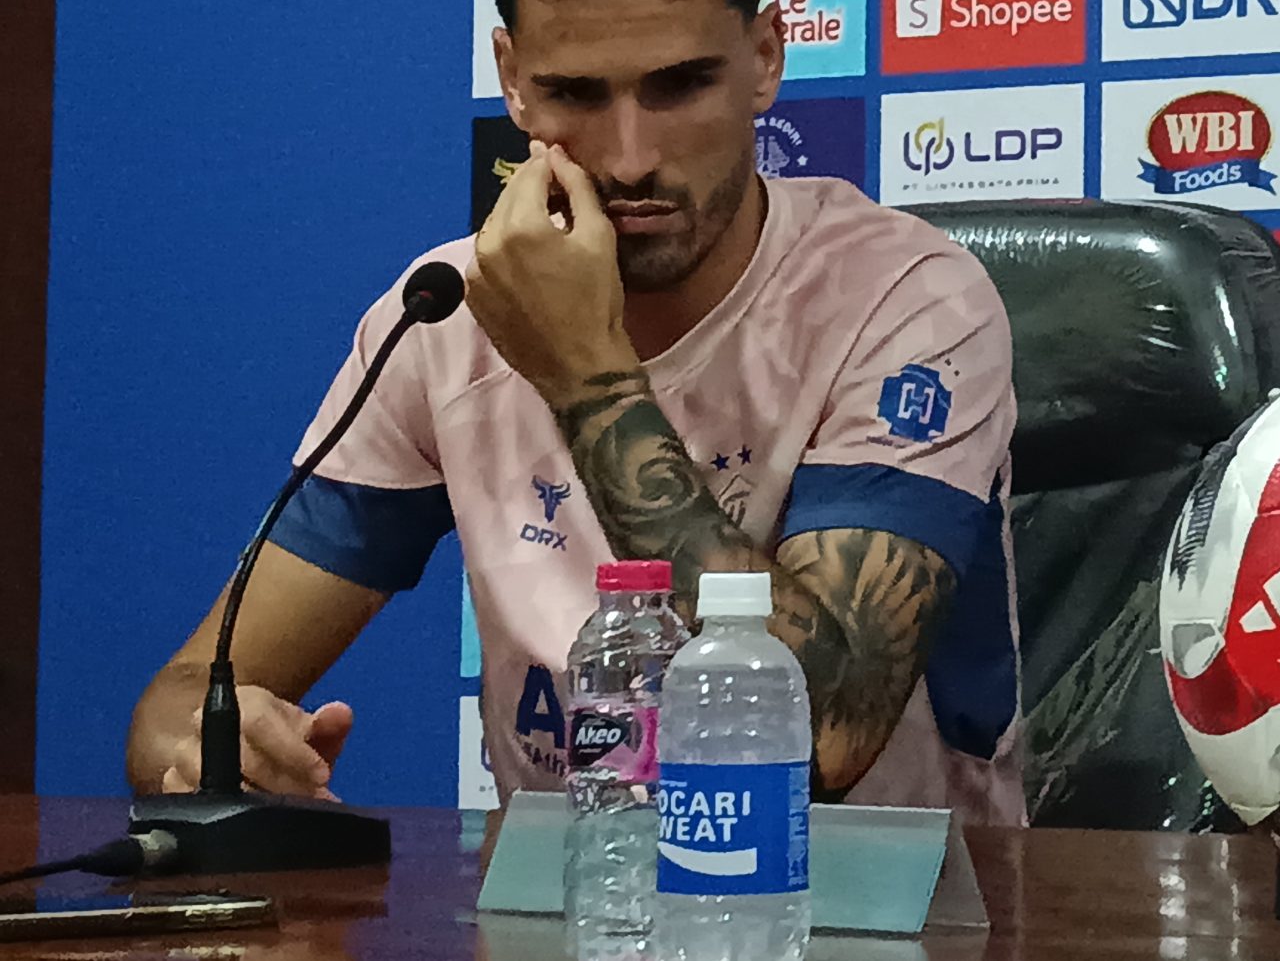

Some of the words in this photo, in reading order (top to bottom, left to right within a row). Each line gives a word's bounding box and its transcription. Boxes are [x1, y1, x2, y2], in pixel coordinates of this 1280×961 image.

[781, 10, 840, 43] erale
[964, 128, 1063, 161] LDP
[1164, 110, 1255, 154] WBI
[1172, 163, 1242, 192] Foods
[657, 789, 751, 816] OCARI
[658, 816, 738, 842] WEAT
